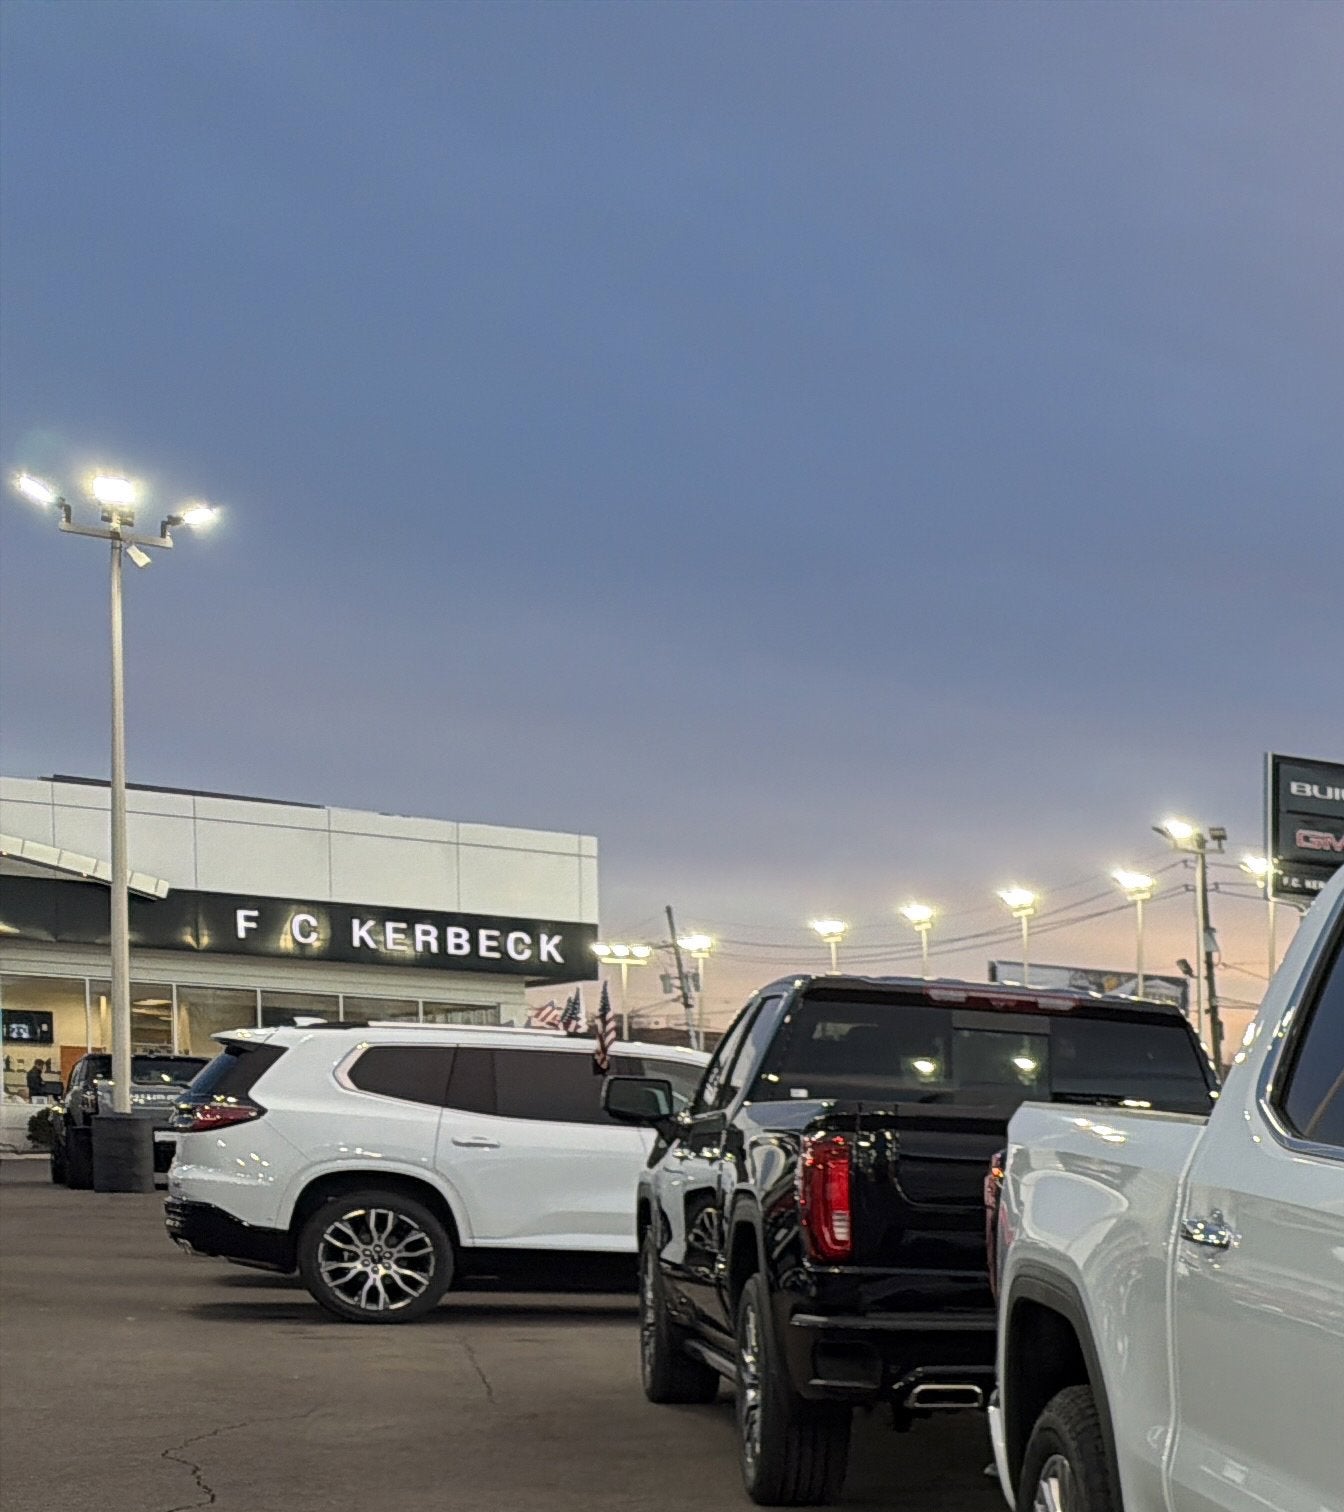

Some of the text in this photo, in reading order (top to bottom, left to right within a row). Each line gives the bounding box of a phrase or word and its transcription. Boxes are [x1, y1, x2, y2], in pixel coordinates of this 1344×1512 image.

[235, 908, 565, 964] F C KERBECK
